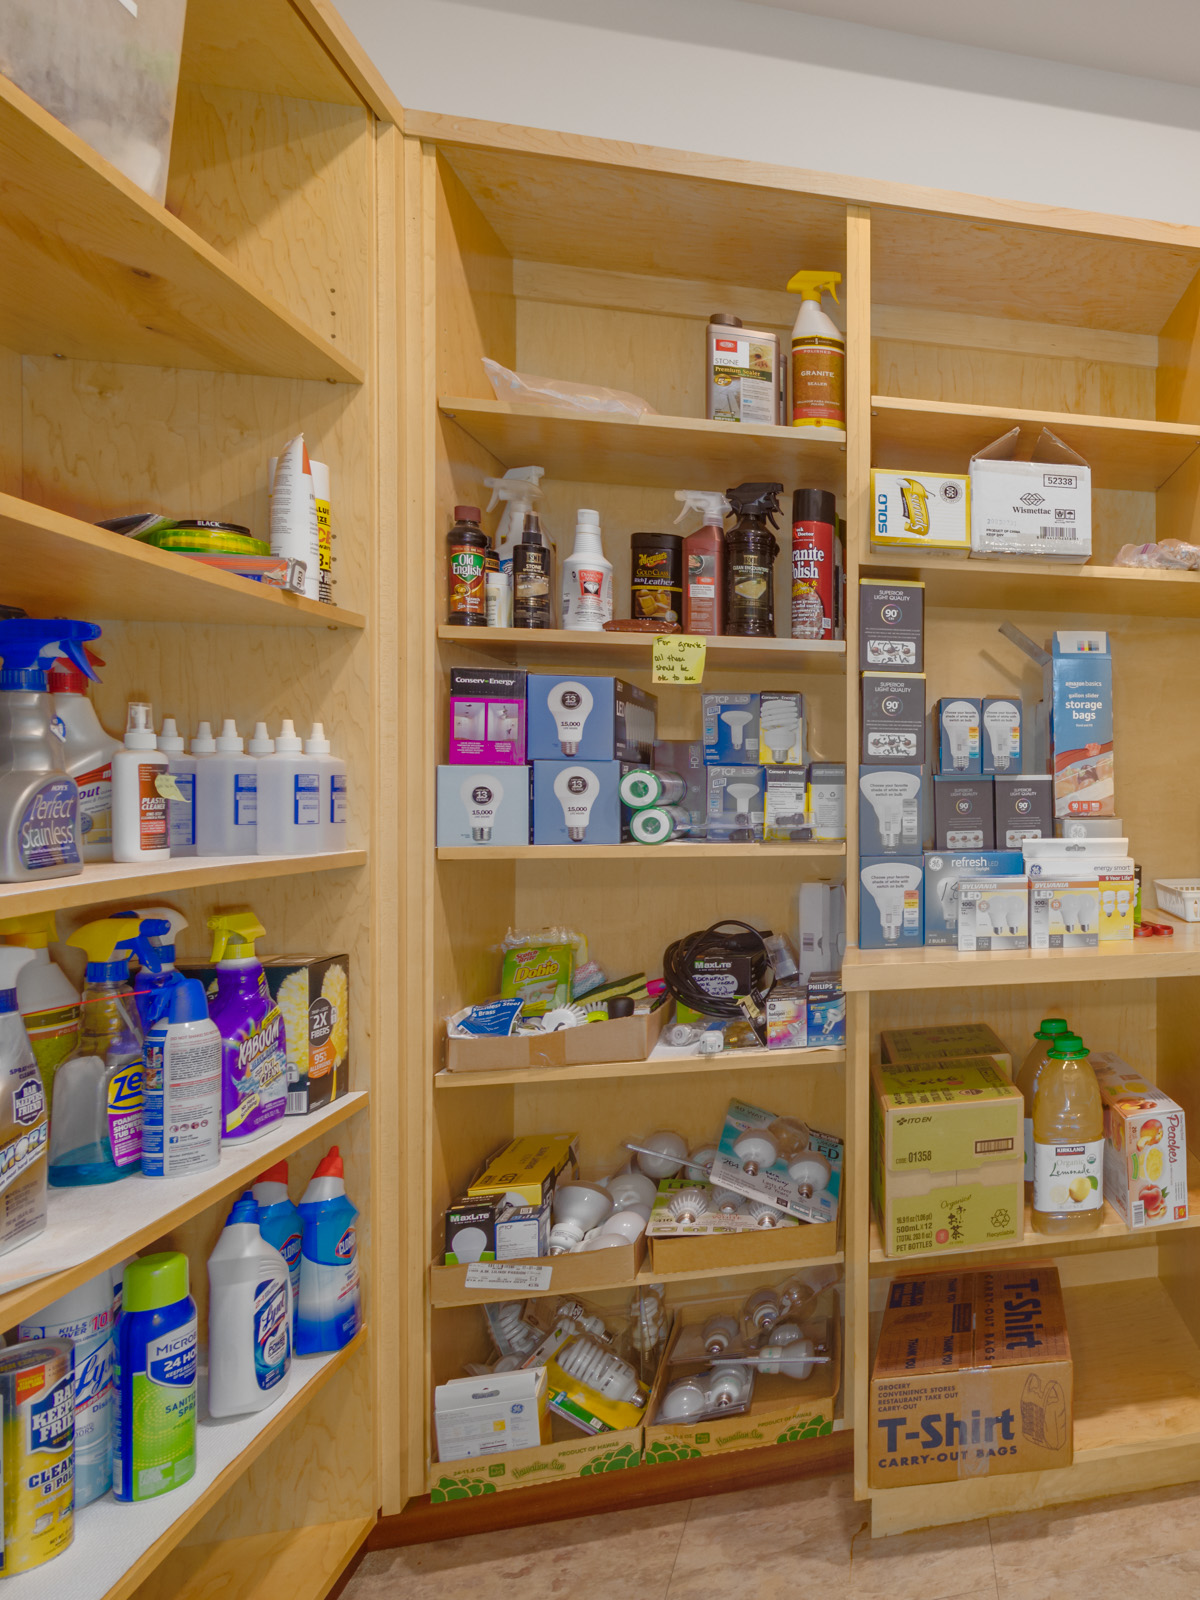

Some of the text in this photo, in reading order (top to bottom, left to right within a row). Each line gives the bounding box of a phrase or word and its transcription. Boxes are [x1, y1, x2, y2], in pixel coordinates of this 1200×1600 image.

[715, 357, 739, 366] STONE
[715, 366, 761, 377] Premium Sealer
[801, 370, 835, 378] GRANITE
[1047, 477, 1073, 486] 52338
[878, 494, 888, 534] SOLO
[910, 493, 926, 532] Spoons
[1012, 506, 1051, 516] Wismettac
[459, 553, 474, 566] Old
[452, 563, 482, 578] English
[644, 577, 675, 587] Leather
[680, 664, 689, 672] be
[565, 695, 576, 703] 13
[714, 695, 729, 704] TCP
[616, 700, 625, 717] LED
[1065, 700, 1103, 711] storage
[1072, 710, 1097, 722] bags
[721, 768, 736, 776] TCP
[571, 780, 583, 788] 13
[476, 790, 488, 799] 13
[30, 792, 74, 820] Perfect
[141, 803, 165, 811] CLEANER
[22, 821, 74, 849] Stainless
[952, 856, 987, 867] refresh
[1094, 865, 1111, 873] energy
[961, 891, 982, 901] LED
[1034, 890, 1054, 900] LED
[514, 961, 560, 984] Dobie
[808, 983, 833, 991] PHILIPS
[313, 1014, 327, 1029] 2X
[310, 1026, 331, 1040] FIBERS
[238, 1018, 280, 1069] KABOOM
[15, 1092, 44, 1110] KEEPERS
[18, 1101, 42, 1118] FRIEND
[907, 1115, 932, 1125] ITO EN
[115, 1127, 136, 1139] TUB &
[1131, 1126, 1138, 1134] 20
[1166, 1114, 1180, 1164] Peaches
[808, 1144, 840, 1160] LED
[896, 1150, 932, 1165] CODE 01358
[1049, 1162, 1091, 1177] Lemonade
[1056, 1158, 1085, 1169] Organic
[986, 1229, 1015, 1239] Recyclable
[896, 1240, 933, 1252] PET BOTTLES
[261, 1293, 285, 1332] Lysol
[983, 1275, 996, 1361] CARRY-OUT BAGS
[1004, 1278, 1044, 1350] T-Shirt
[58, 1320, 88, 1335] KILLS
[61, 1327, 88, 1338] OVER
[878, 1383, 911, 1391] GROCERY
[878, 1385, 956, 1399] CONVENIENCE STORES
[878, 1396, 922, 1405] RESTAURANT
[925, 1393, 942, 1401] TAKE
[878, 1403, 917, 1413] CARRY-OUT
[878, 1408, 1015, 1453] T-Shirt
[878, 1445, 1018, 1469] CARRY-OUT BAGS
[512, 1460, 549, 1480] Hawaiian
